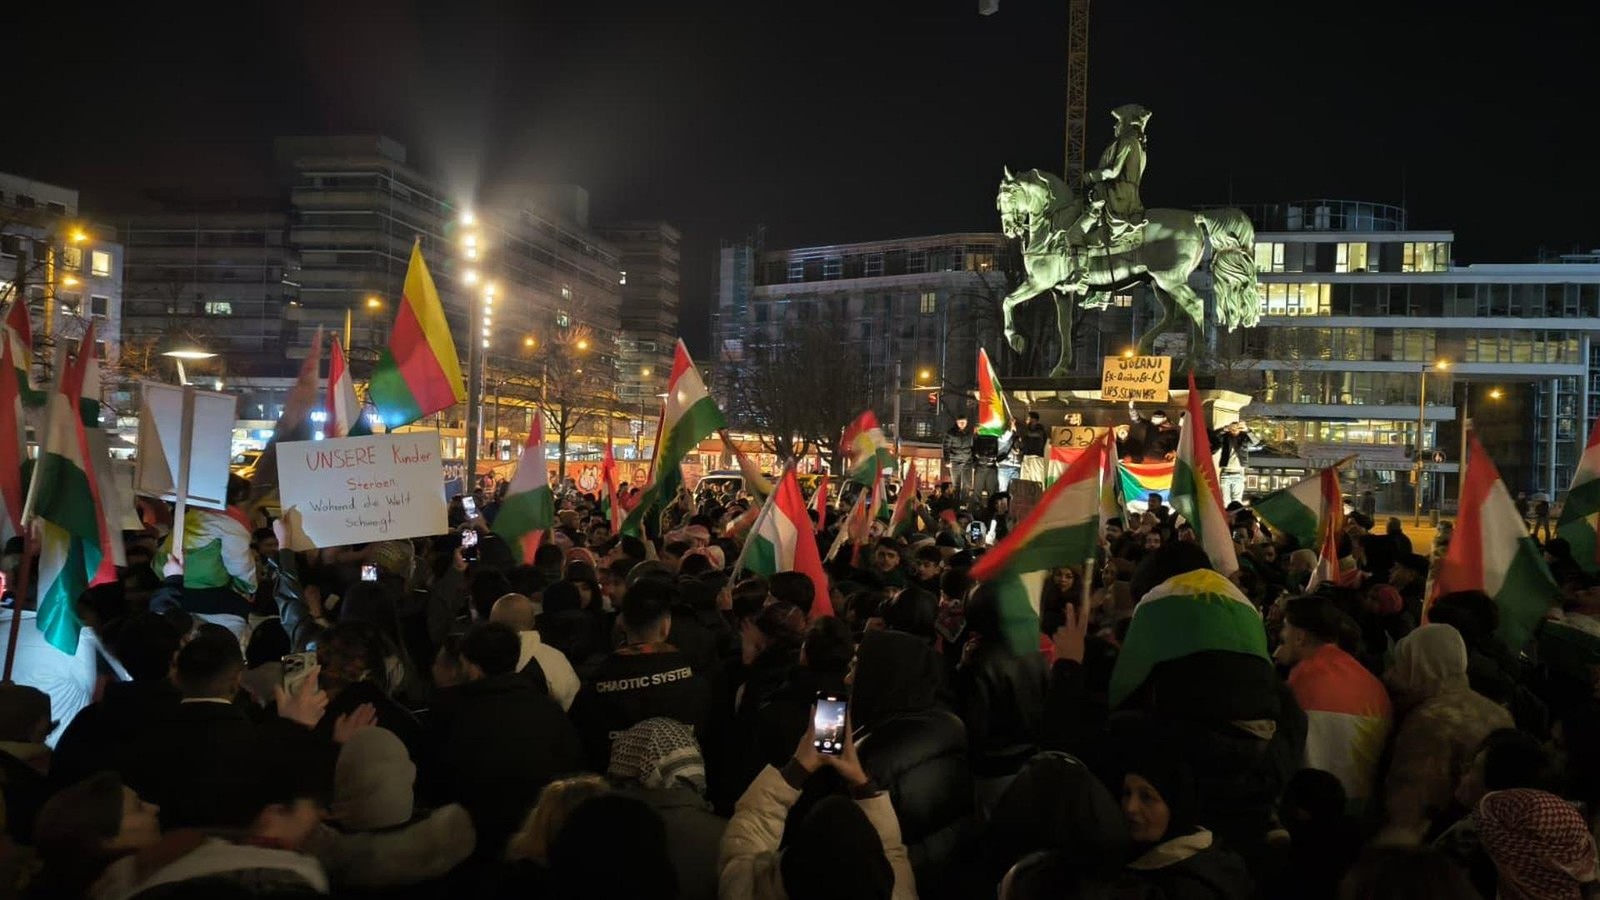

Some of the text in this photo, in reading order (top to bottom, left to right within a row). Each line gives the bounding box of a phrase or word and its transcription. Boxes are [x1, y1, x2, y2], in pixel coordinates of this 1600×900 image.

[1118, 357, 1162, 370] JOLANI
[306, 444, 432, 471] UNSERE Kinder
[385, 492, 410, 506] Welt
[596, 676, 650, 693] CHAOTIC
